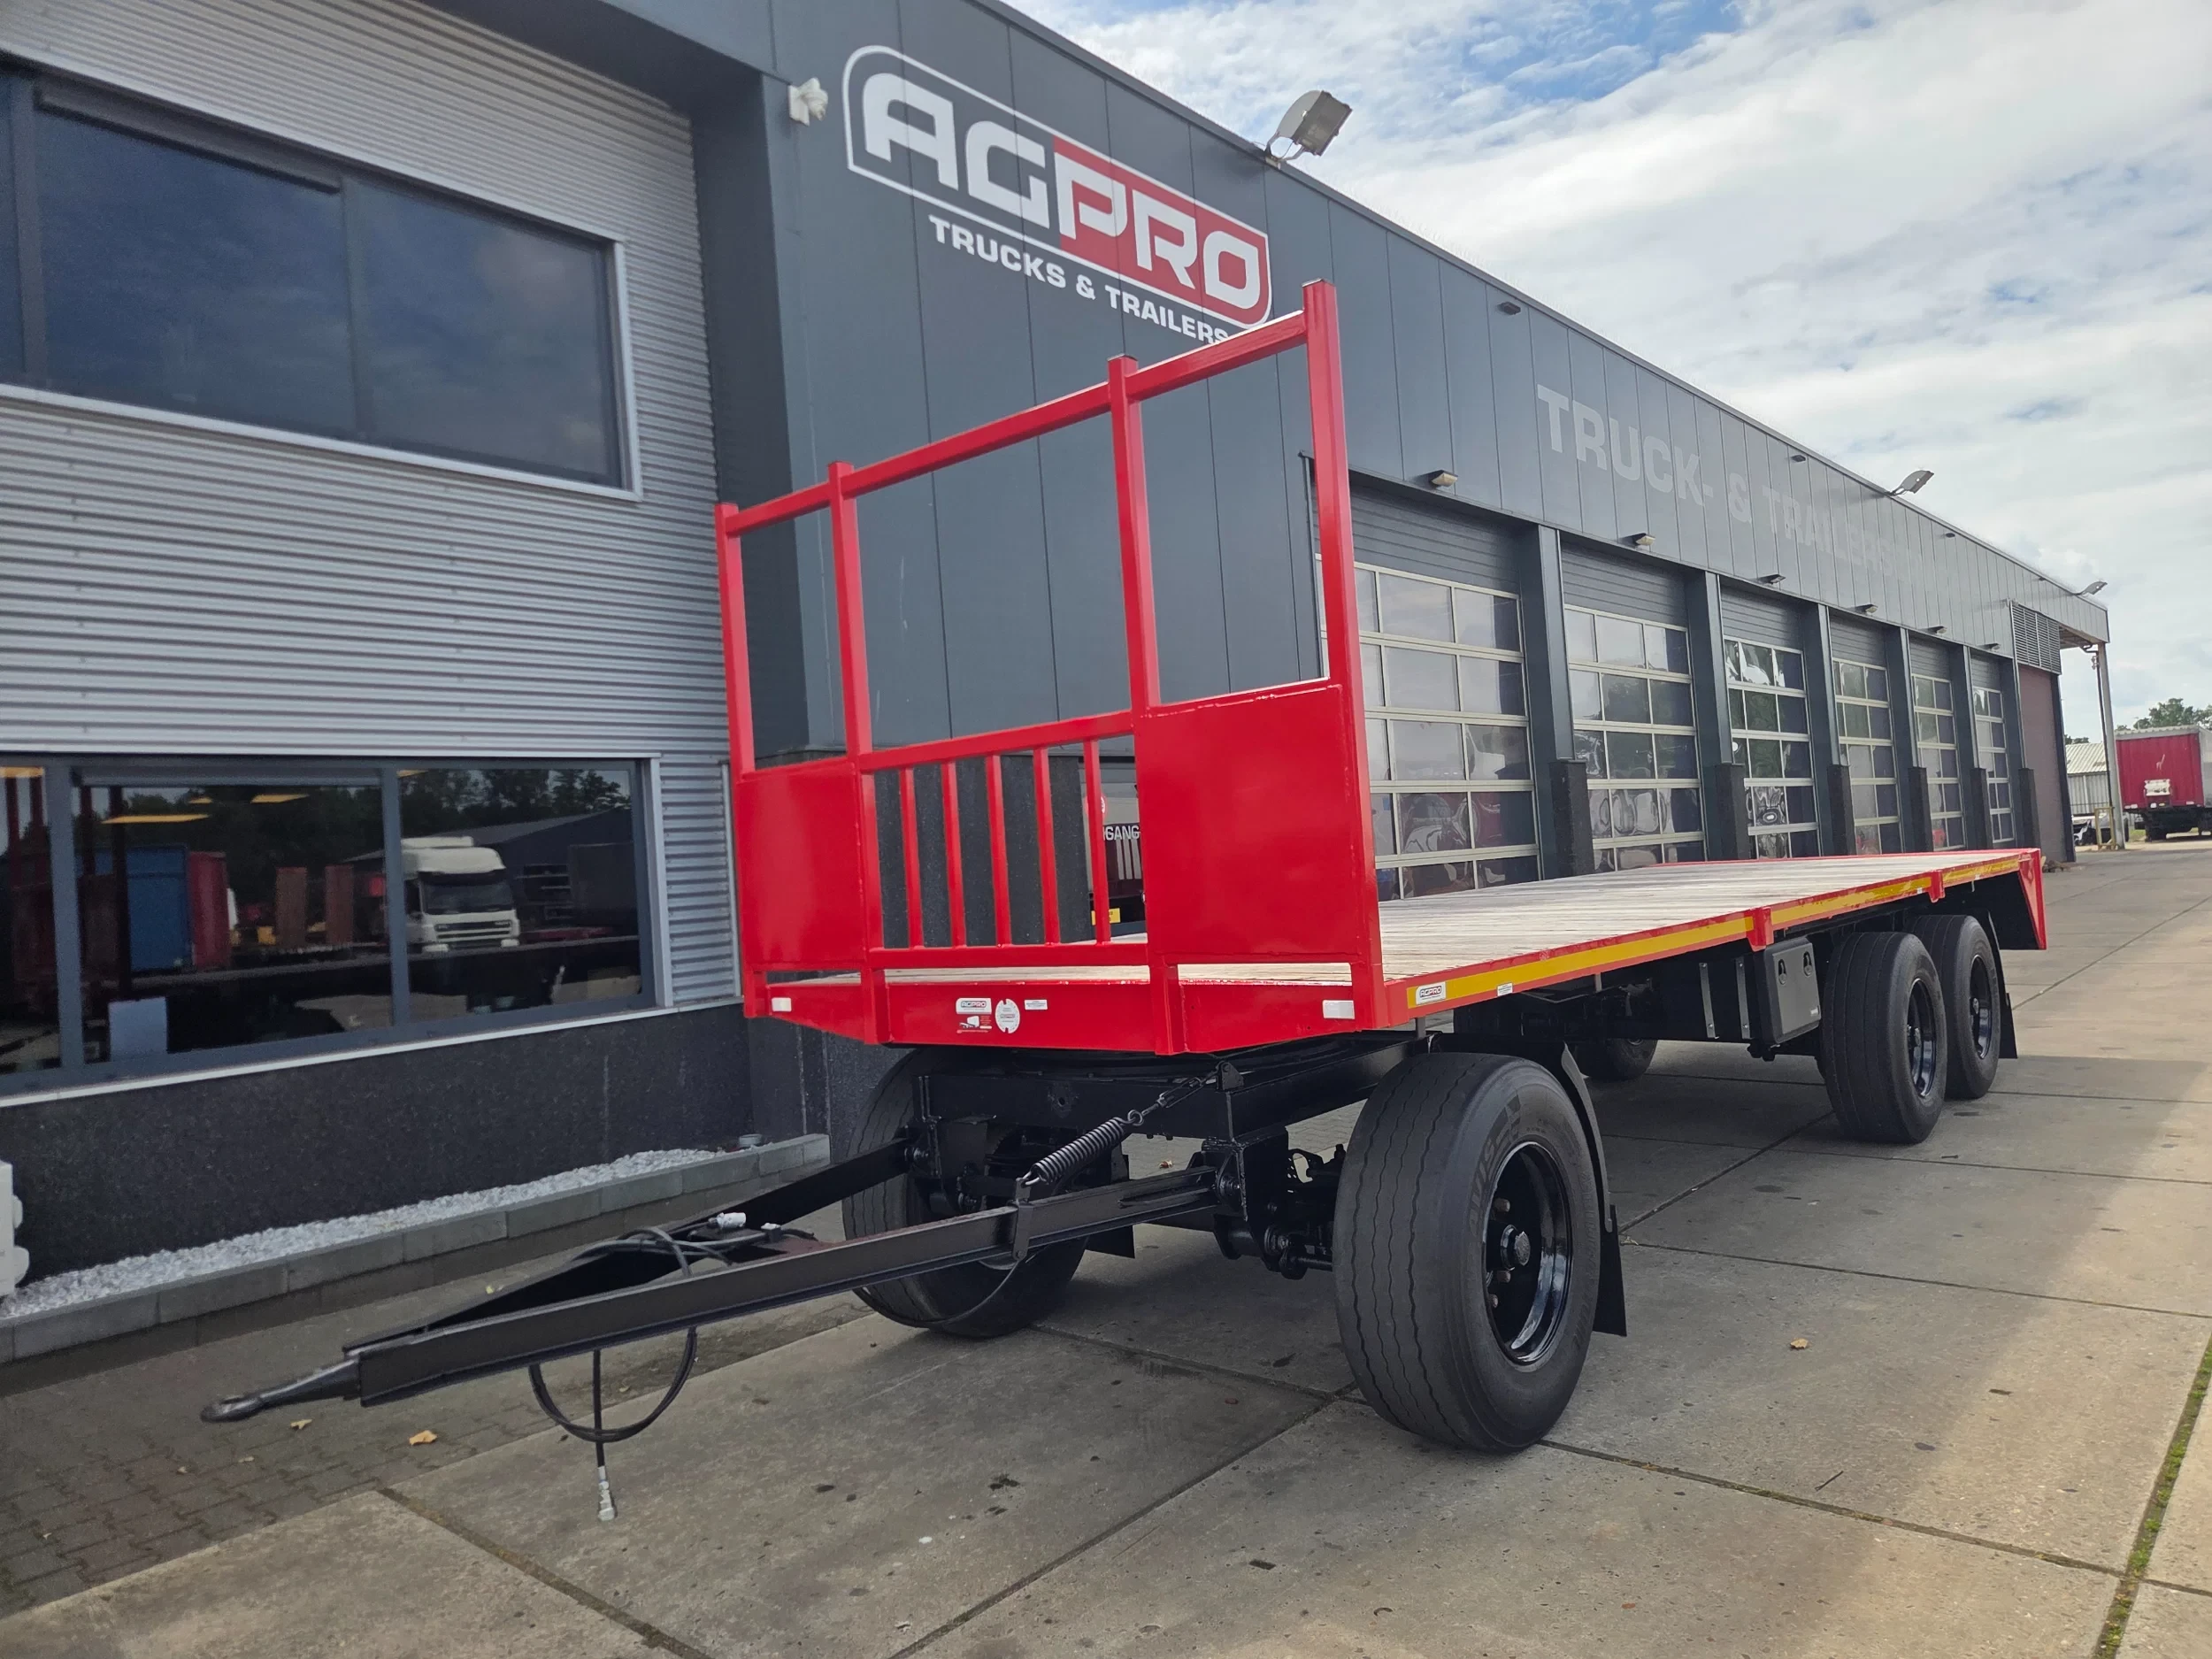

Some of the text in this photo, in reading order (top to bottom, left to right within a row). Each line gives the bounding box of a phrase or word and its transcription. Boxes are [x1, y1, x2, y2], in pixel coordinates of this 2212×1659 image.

[863, 73, 1260, 309] AGPRO
[929, 214, 1228, 344] TRUCKS & TRAILERS
[1536, 383, 1714, 506] TRUCK-
[1728, 472, 1753, 524] &
[1420, 986, 1441, 997] AGPRO
